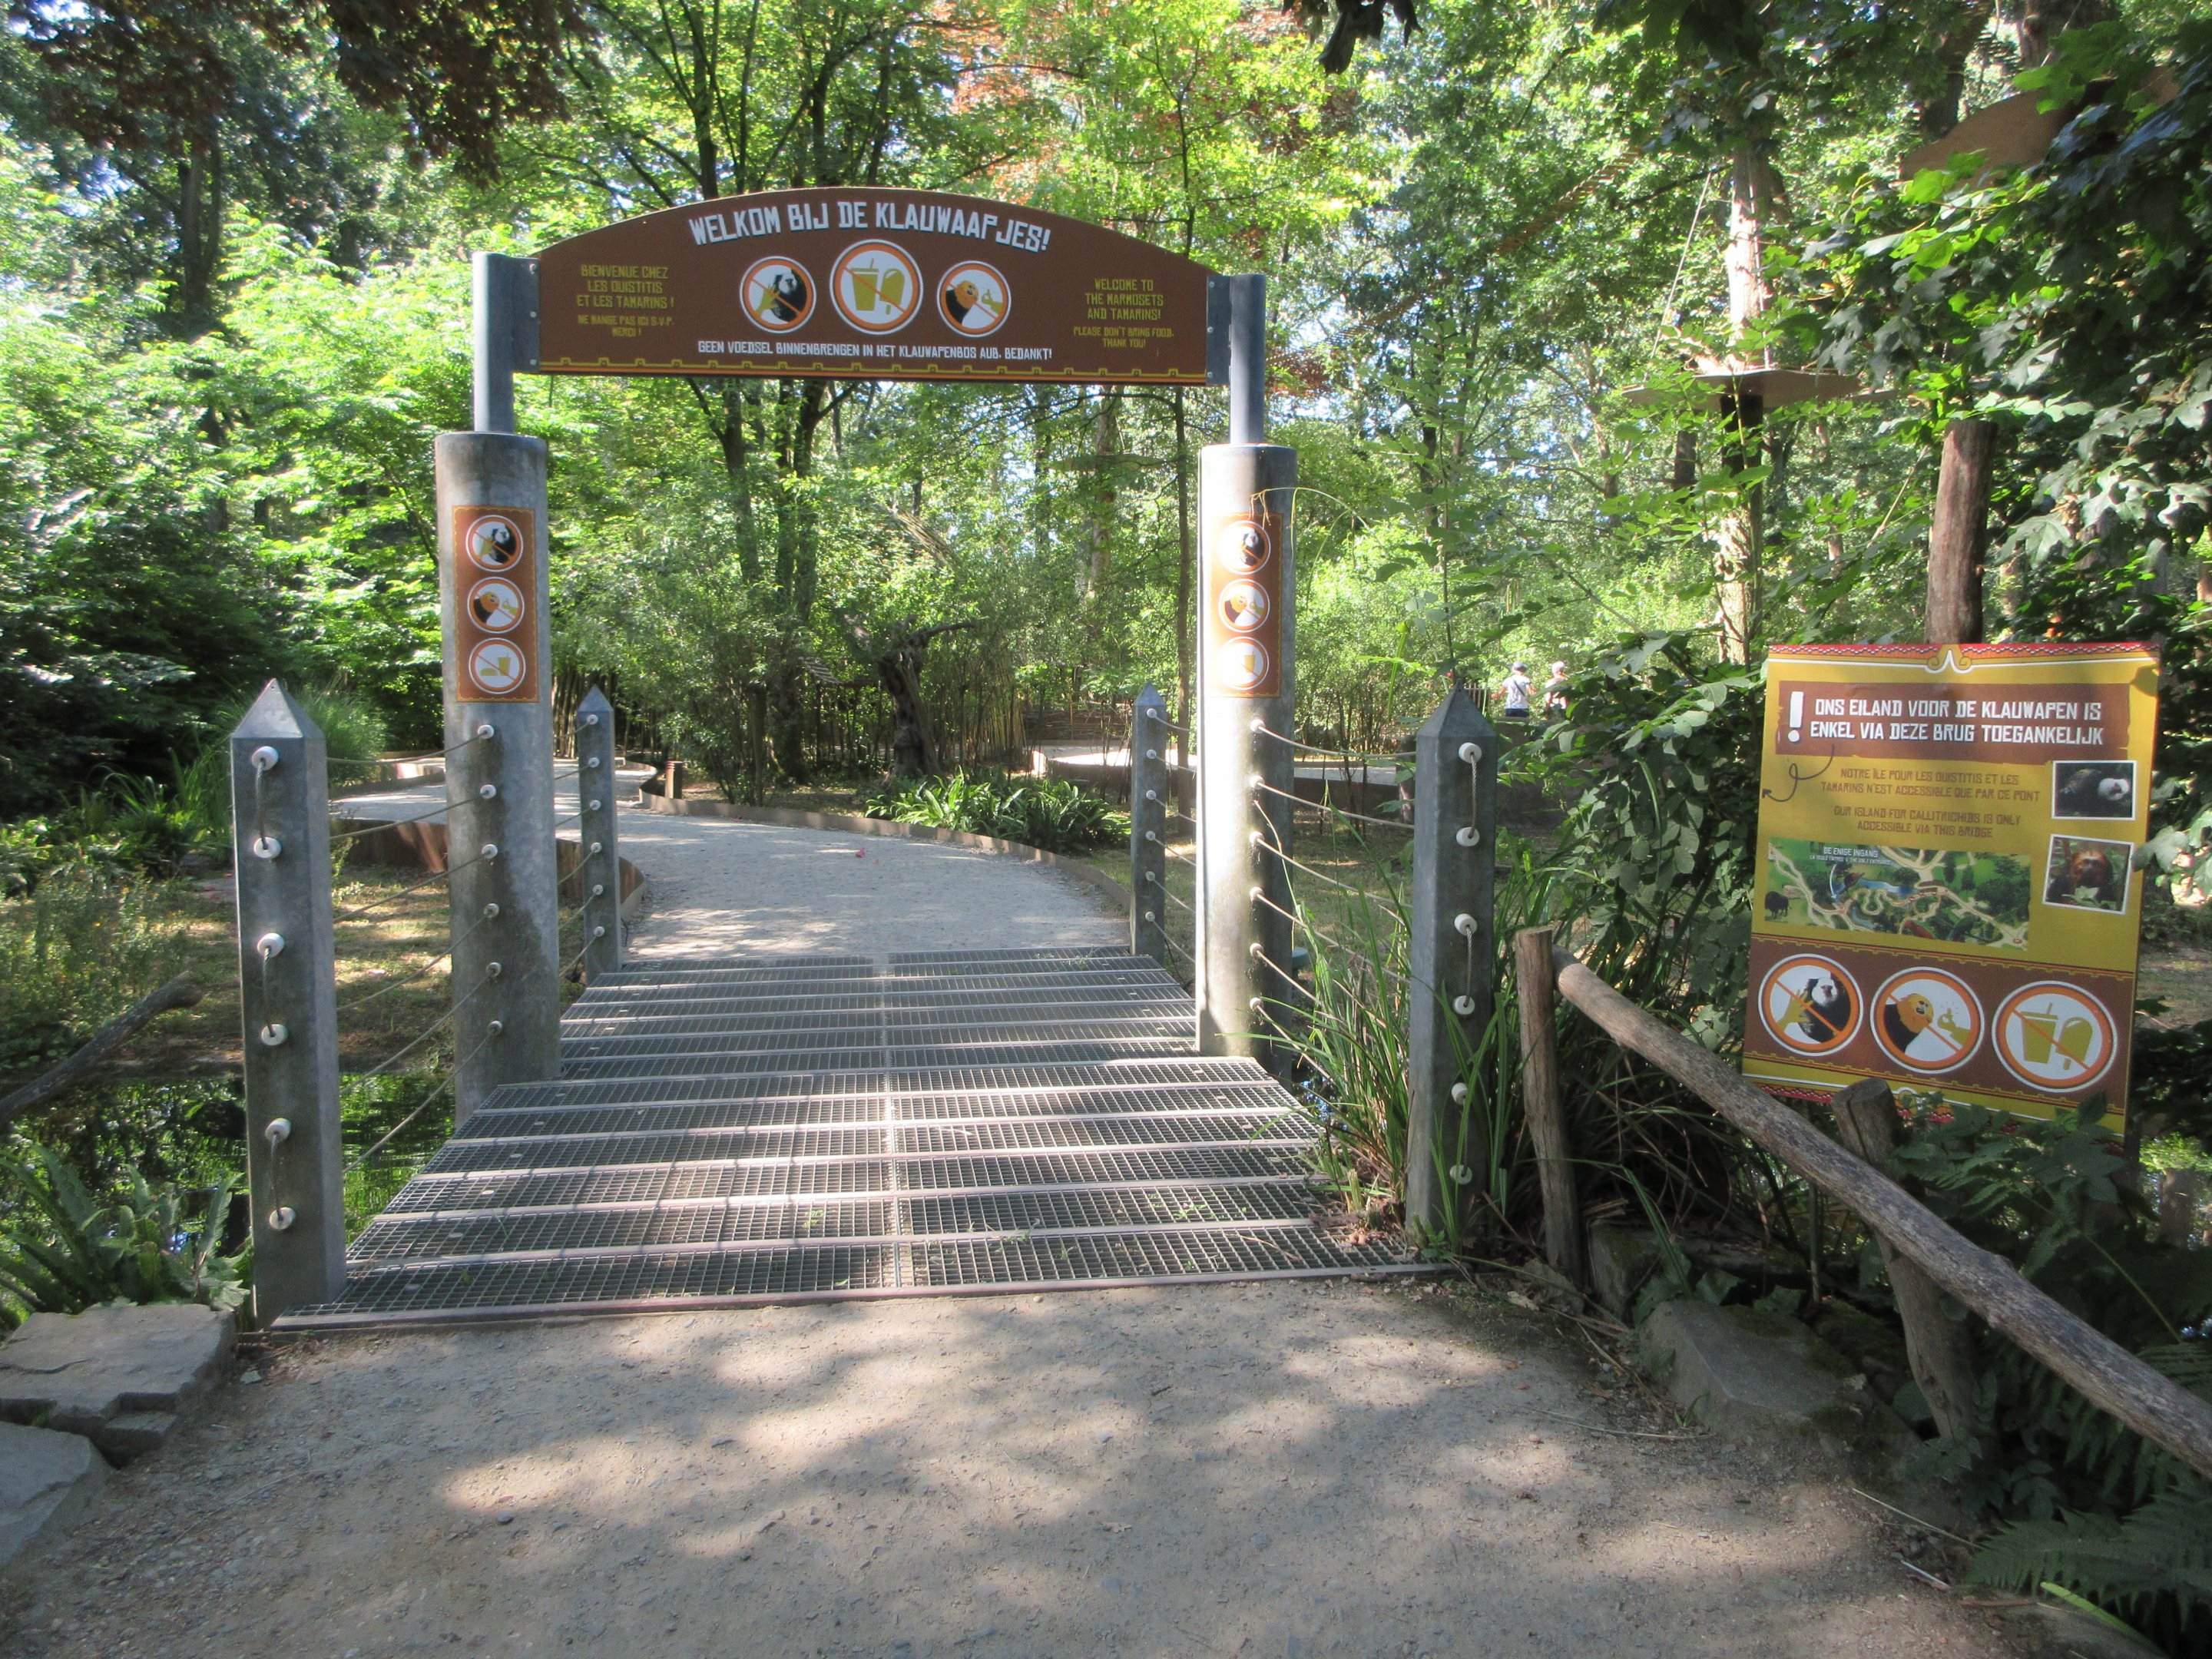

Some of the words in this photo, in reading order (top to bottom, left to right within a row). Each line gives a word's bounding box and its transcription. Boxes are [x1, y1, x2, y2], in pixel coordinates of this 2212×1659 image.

[689, 206, 781, 246] WELKOM
[786, 203, 829, 231] BIJ
[837, 201, 868, 228] DE
[875, 202, 1051, 253] KLAUWAAPJES!
[581, 265, 639, 277] BIENVENUE
[642, 267, 668, 279] CHEZ
[588, 280, 608, 292] LES
[611, 281, 663, 293] OUISTITIS
[1094, 278, 1137, 291] WELCOME
[1141, 279, 1154, 291] TO
[577, 295, 590, 306] ET
[594, 295, 613, 307] LES
[616, 296, 667, 309] TAMARINS
[1085, 293, 1104, 305] THE
[1107, 293, 1164, 306] MARMOSETS
[619, 316, 635, 326] PAS
[1088, 308, 1107, 320] AND
[1111, 308, 1161, 320] TAMARINS!
[1074, 326, 1101, 336] PLEASE
[1104, 326, 1125, 336] DON'T
[1128, 327, 1150, 337] BRING
[698, 340, 724, 353] GEEN
[728, 341, 773, 354] VOEDSEL
[776, 342, 860, 356] BINNENBRENGEN
[863, 344, 873, 356] IN
[876, 345, 896, 357] HET
[899, 345, 976, 359] KLAUWAPENBOS
[980, 347, 1002, 359] AUB.
[1005, 347, 1052, 360] BEDANKT!
[1102, 338, 1127, 348] THANK
[1130, 339, 1146, 348] YOU!
[1815, 698, 1845, 717] ONS
[1849, 699, 1902, 717] EILAND
[1908, 700, 1949, 718] VOOR
[1955, 700, 1977, 719] DE
[1982, 701, 2078, 720] KLAUWAPEN
[2084, 702, 2101, 720] IS
[1810, 721, 1855, 739] ENKEL
[1859, 723, 1884, 740] VIA
[1889, 724, 1928, 740] DEZE
[1933, 724, 1975, 742] BRUG
[1981, 724, 2103, 745] TOEGANKELIJK
[1841, 768, 1870, 779] NOTRE
[1889, 770, 1912, 780] POUR
[1916, 771, 1932, 781] LES
[1936, 772, 1982, 783] OUISTITIS
[1985, 774, 1998, 784] ET
[2001, 775, 2018, 785] LES
[1821, 782, 1864, 793] TAMARINS
[1866, 783, 1892, 794] N'EST
[1896, 785, 1952, 796] ACCESSIBLE
[1954, 787, 1972, 798] QUE
[1975, 788, 1995, 799] PAR
[1997, 790, 2010, 800] CE
[2013, 790, 2040, 801] PONT
[1834, 806, 1851, 816] OUR
[1854, 807, 1886, 818] ISLAND
[1889, 809, 1906, 820] FOR
[1983, 813, 1992, 823] IS
[1996, 814, 2021, 826] ONLY
[1858, 820, 1912, 833] ACCESSIBLE
[1916, 823, 1930, 834] VIA
[1933, 824, 1955, 836] THIS
[1958, 826, 1993, 837] BRIDGE
[1833, 847, 1852, 856] ENIGE
[1853, 849, 1878, 858] INGANG
